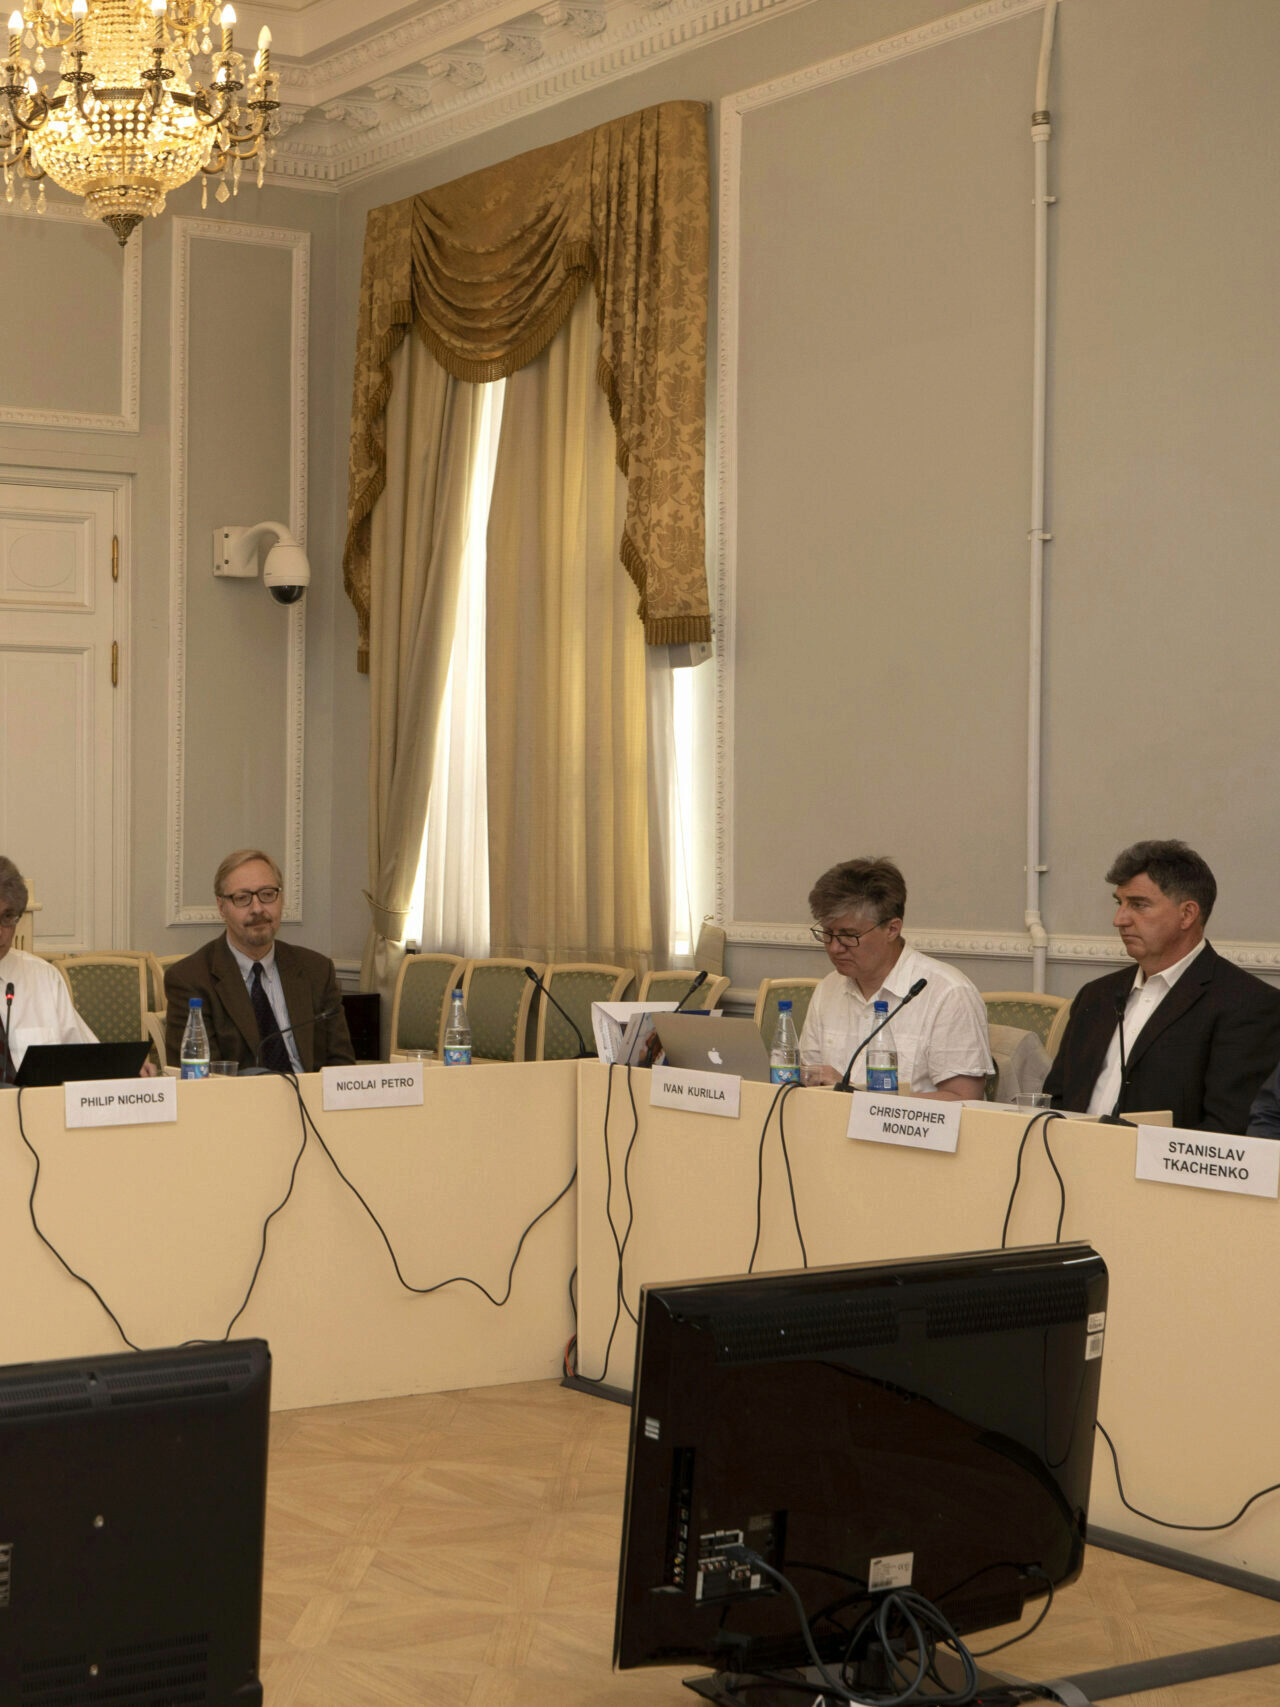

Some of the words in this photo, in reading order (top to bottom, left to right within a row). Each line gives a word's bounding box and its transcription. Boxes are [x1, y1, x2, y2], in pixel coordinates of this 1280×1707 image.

[336, 1079, 377, 1092] NICOLAI
[381, 1076, 415, 1090] PETRO
[663, 1082, 684, 1096] IVAN
[687, 1086, 726, 1101] KURILLA
[80, 1094, 115, 1108] PHILIP
[117, 1091, 166, 1106] NICHOLS
[869, 1105, 946, 1126] CHRISTOPHER
[882, 1121, 930, 1139] MONDAY
[1168, 1140, 1246, 1162] STANISLAV
[1162, 1157, 1250, 1181] TKACHENKO
